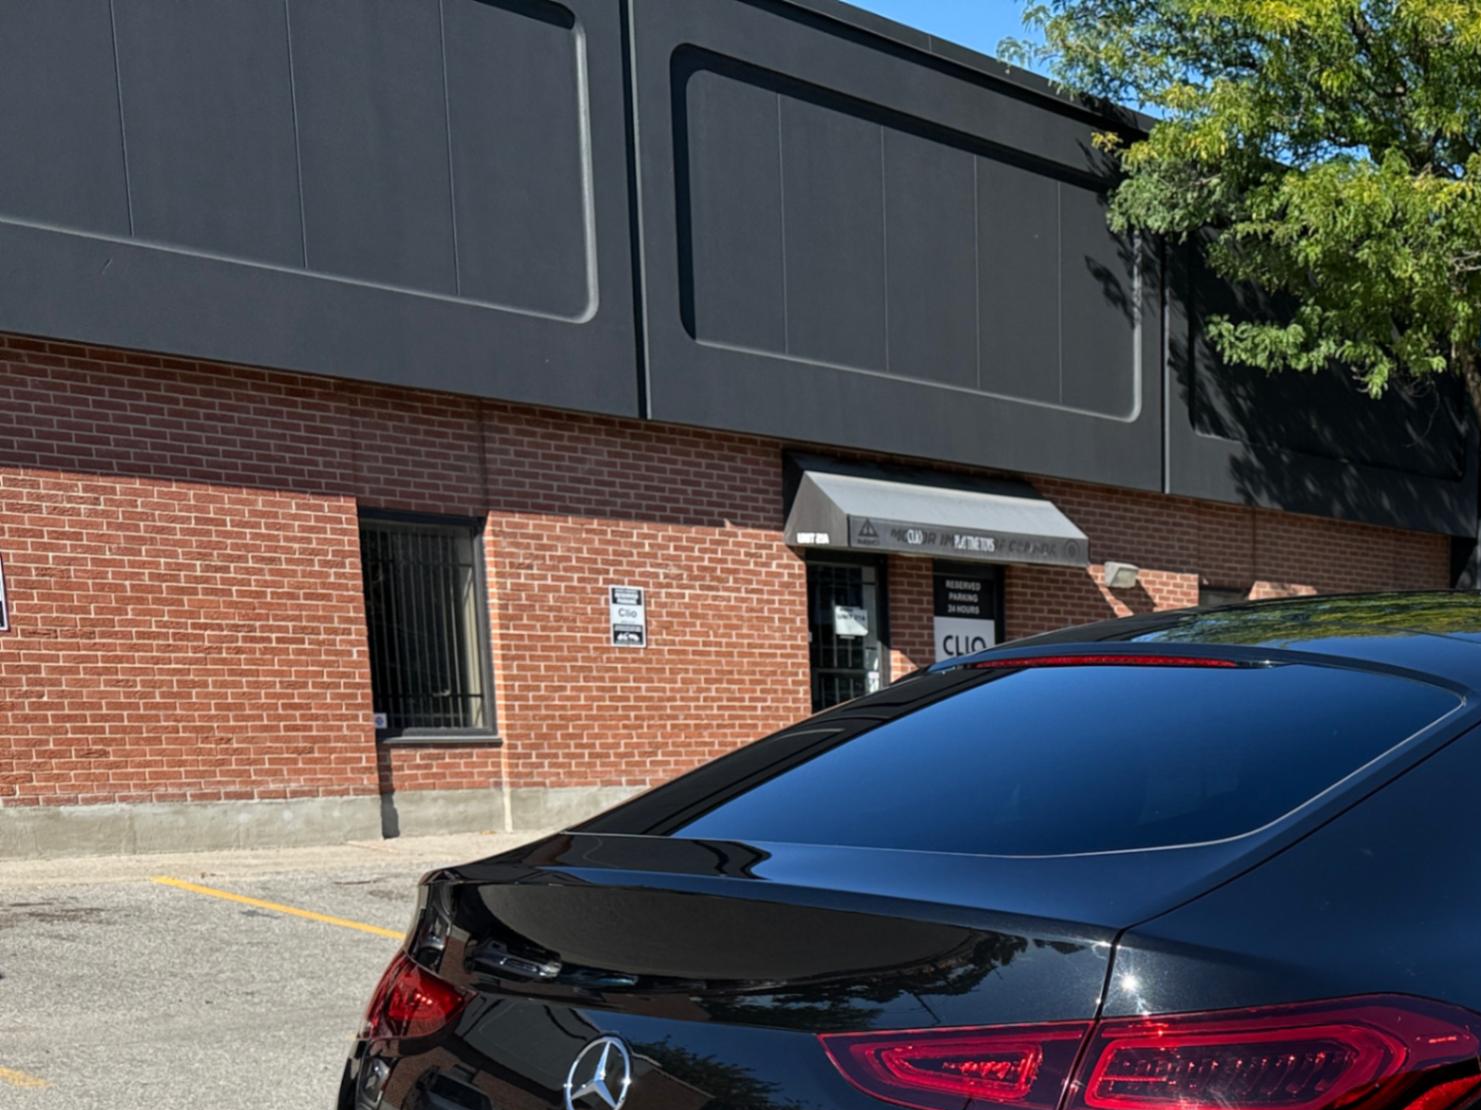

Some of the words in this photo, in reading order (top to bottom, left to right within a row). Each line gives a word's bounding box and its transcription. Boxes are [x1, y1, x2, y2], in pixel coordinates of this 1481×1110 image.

[945, 580, 981, 591] RESERVED
[948, 592, 978, 603] PARKING
[957, 605, 980, 615] HOURS
[943, 635, 987, 656] CLIO
